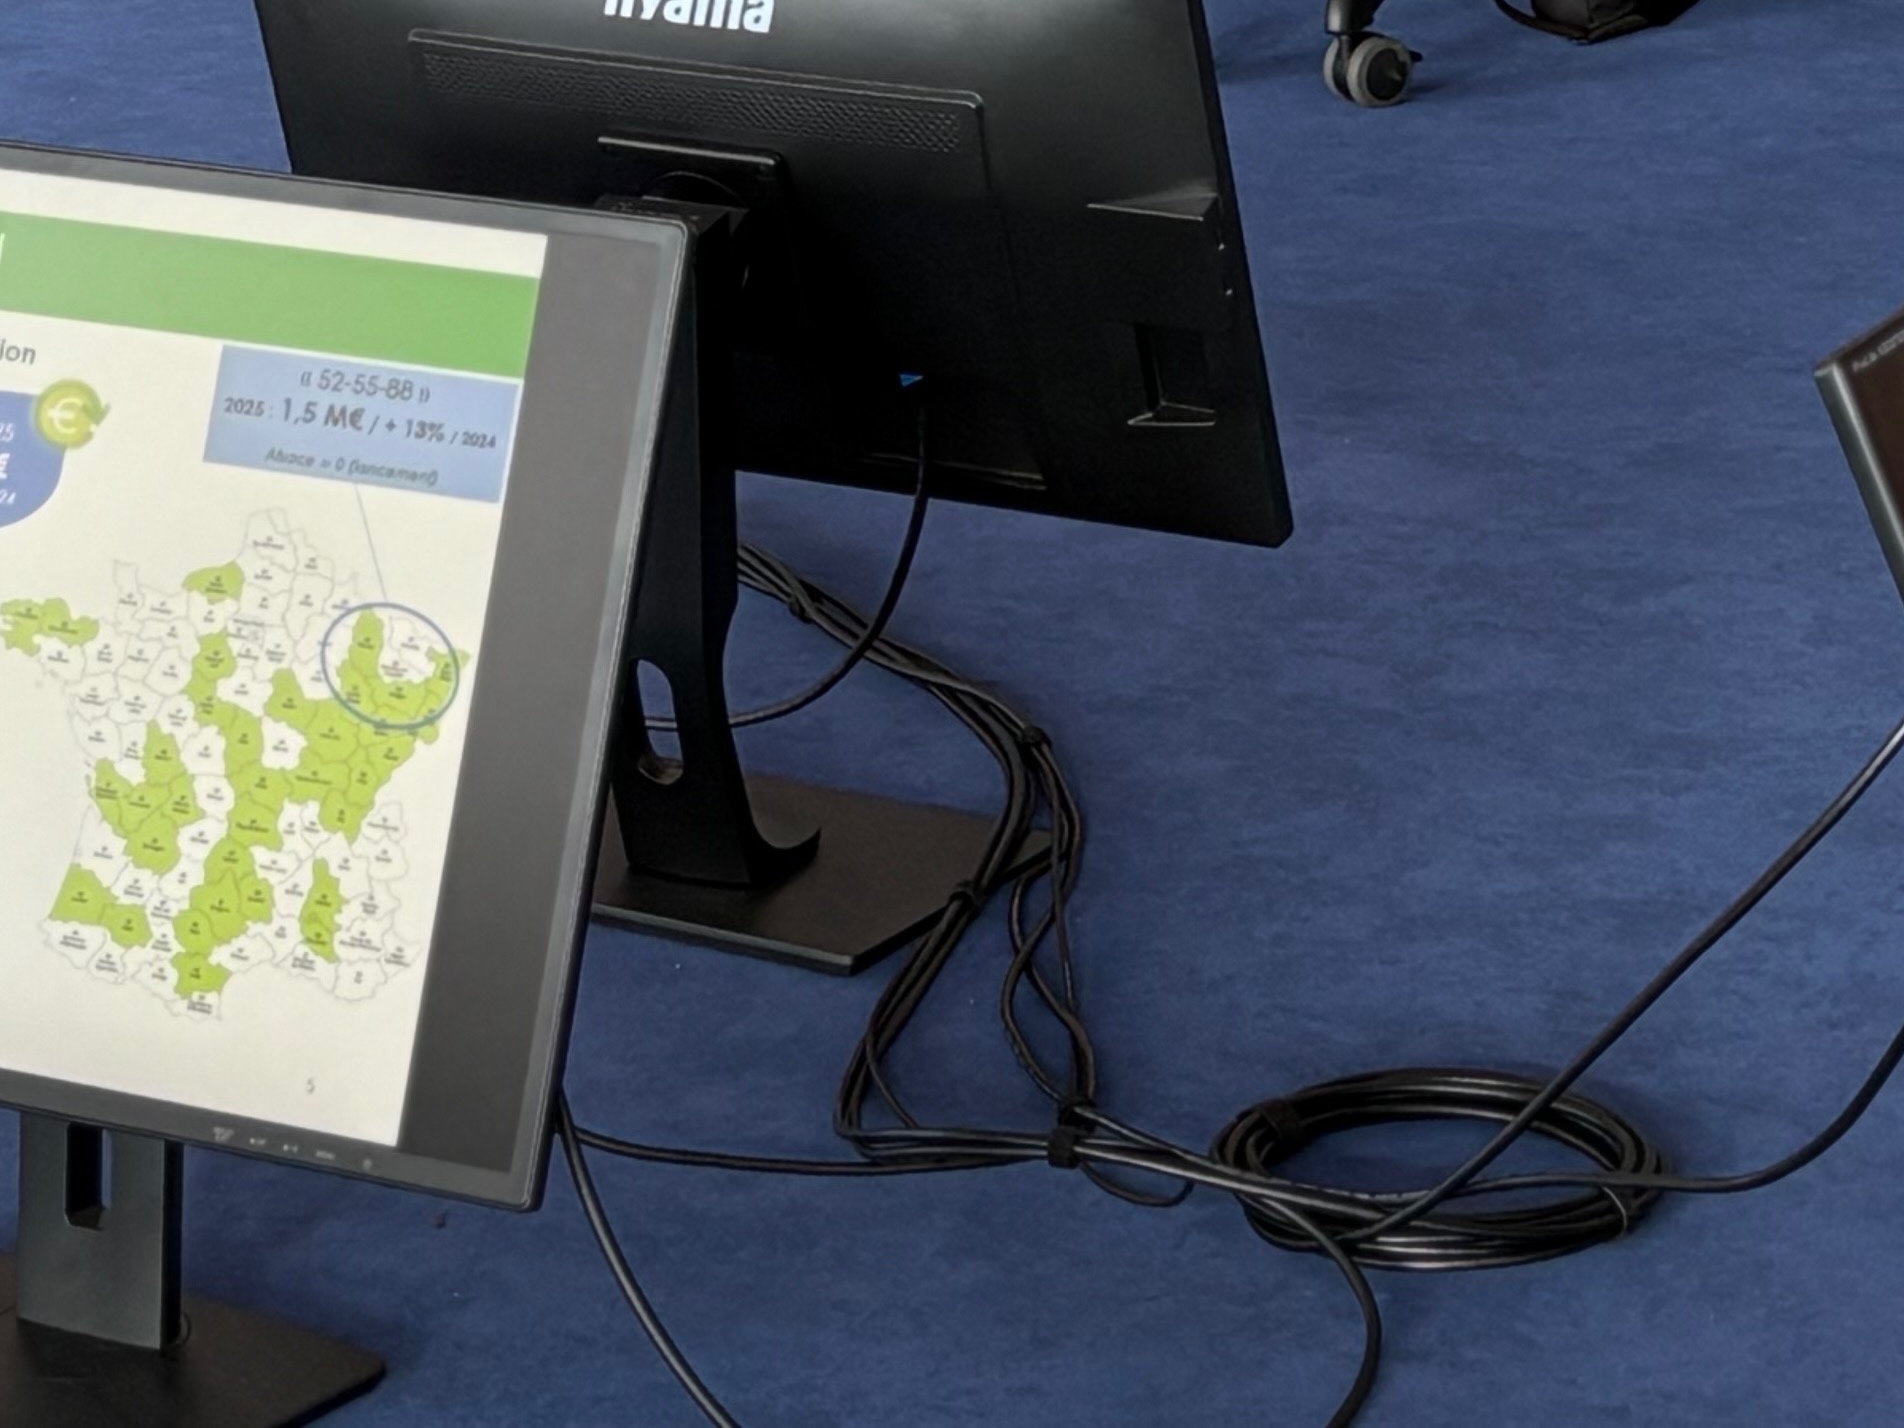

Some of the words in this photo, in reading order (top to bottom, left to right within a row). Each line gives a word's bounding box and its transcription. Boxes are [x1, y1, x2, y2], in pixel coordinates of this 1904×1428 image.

[317, 368, 414, 401] 52-55-88
[282, 397, 318, 425] 1,5
[322, 403, 365, 431] M€
